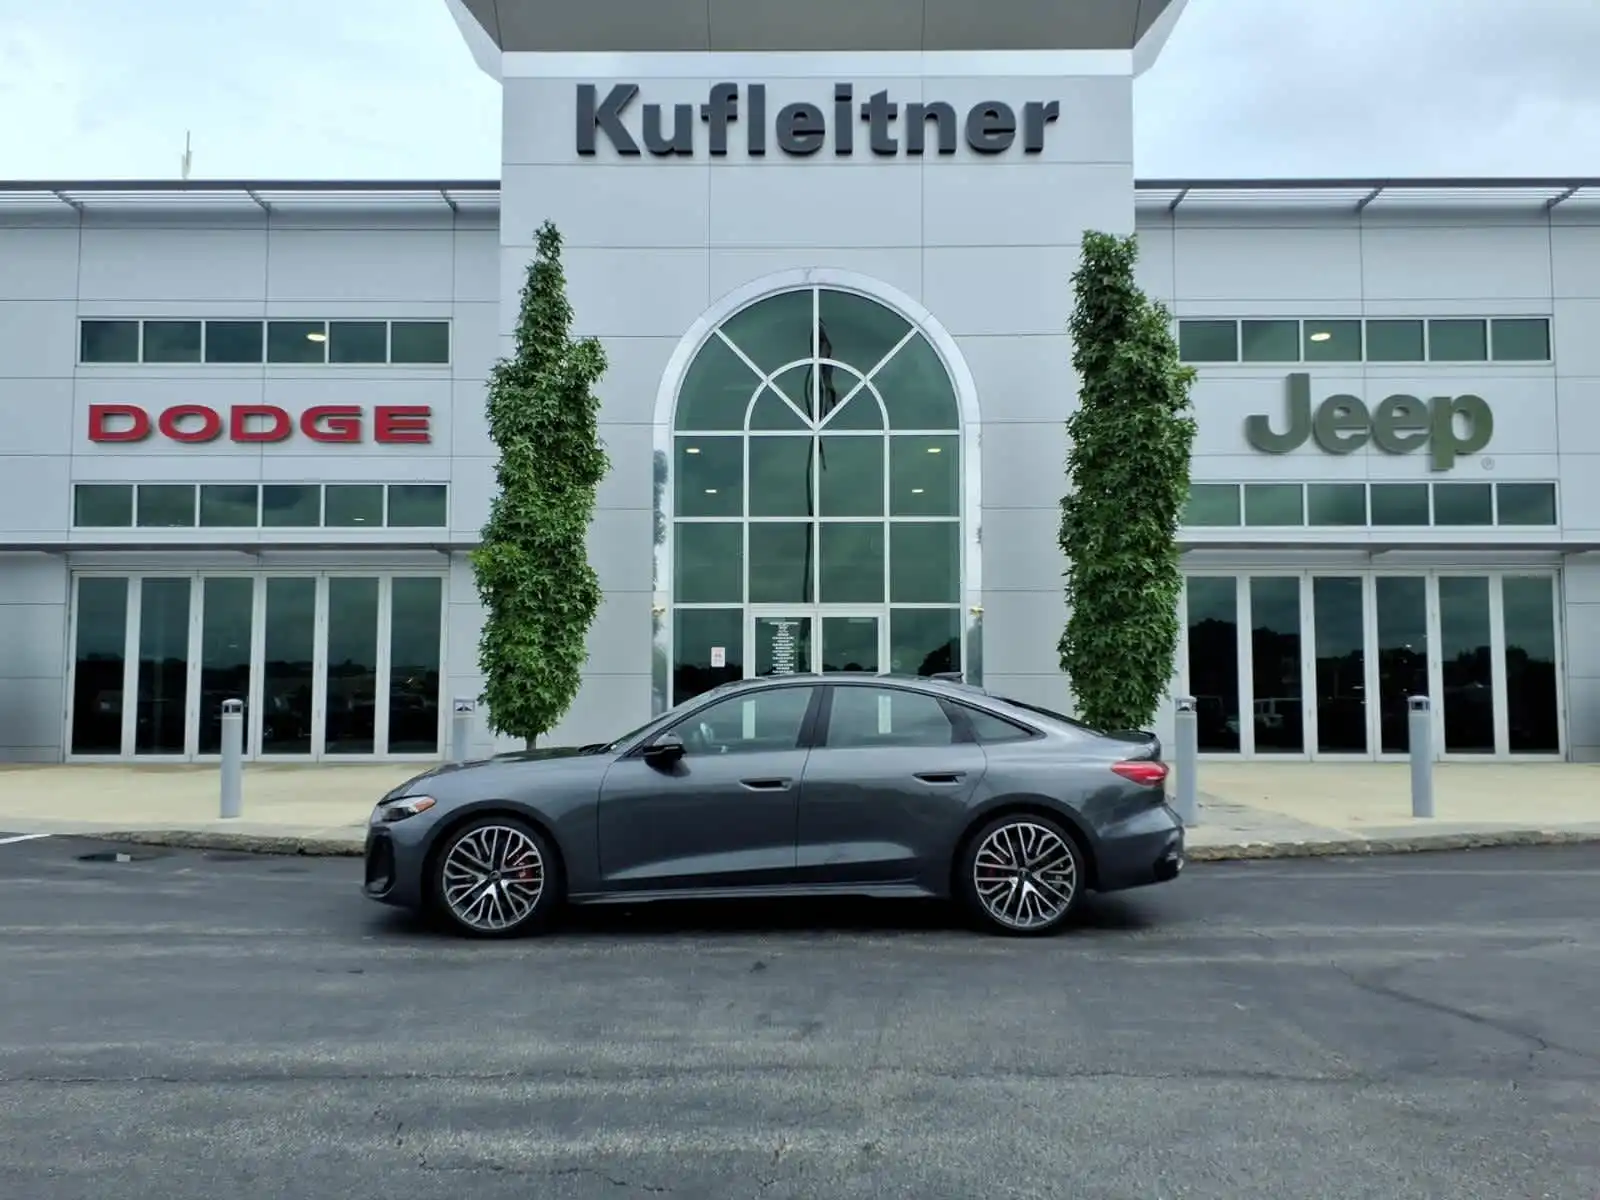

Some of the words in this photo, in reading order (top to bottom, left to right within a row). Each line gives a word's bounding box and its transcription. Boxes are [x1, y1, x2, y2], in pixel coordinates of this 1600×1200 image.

[576, 82, 1060, 157] Kufleitner
[88, 404, 431, 443] DODGE
[1245, 373, 1494, 472] Jeep
